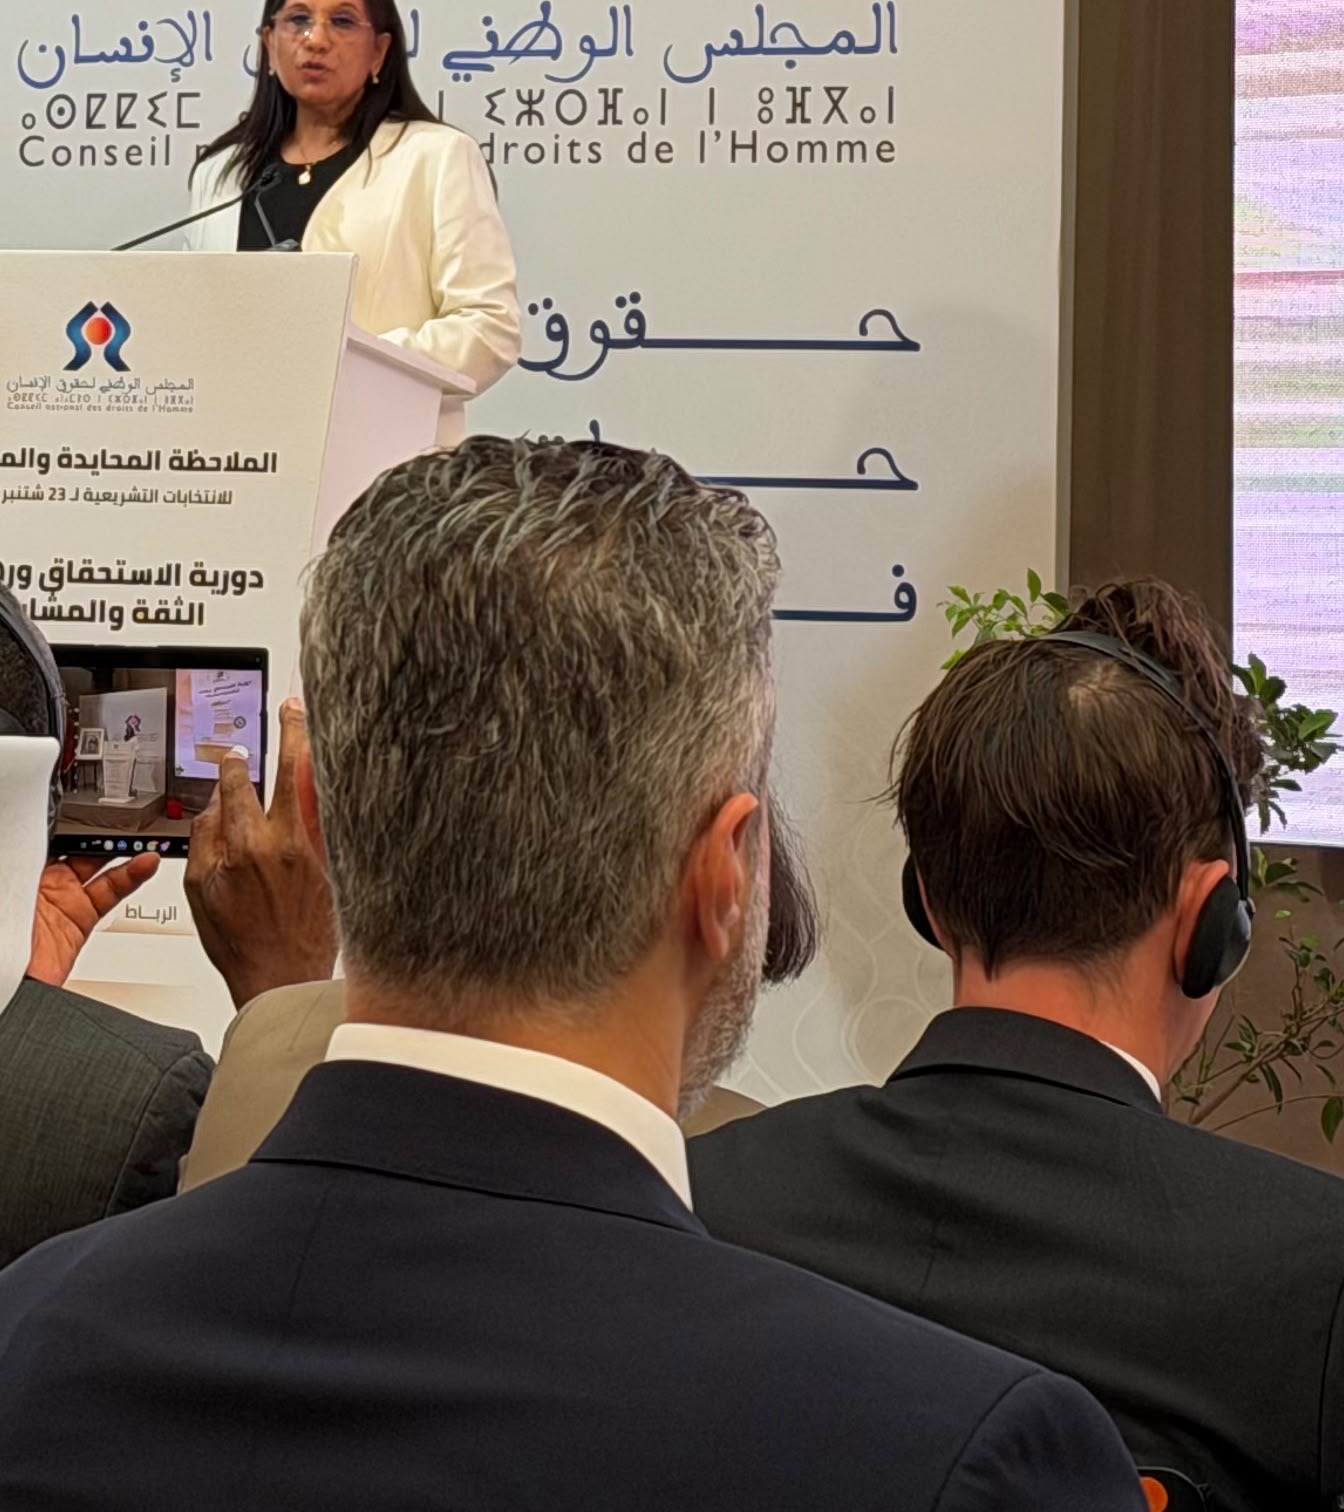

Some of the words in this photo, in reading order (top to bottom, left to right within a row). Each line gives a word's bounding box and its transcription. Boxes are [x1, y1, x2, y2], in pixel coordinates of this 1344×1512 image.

[17, 9, 212, 90] الإنسان
[442, 0, 634, 83] الوطني
[663, 0, 898, 84] المجلس
[19, 134, 170, 167] Conseil
[479, 133, 602, 165] droits
[627, 133, 674, 164] de
[699, 131, 896, 164] l'Homme
[57, 446, 161, 476] المحايدة
[168, 448, 278, 474] الملاحظة
[2, 485, 45, 504] شتنبر
[48, 487, 66, 501] 23
[84, 488, 159, 507] التشريعية
[163, 490, 233, 507] للانتخابات
[39, 557, 182, 592] الاستحقاق
[189, 561, 265, 596] دورية
[132, 596, 205, 627] الثقة
[125, 905, 177, 924] الرباط
